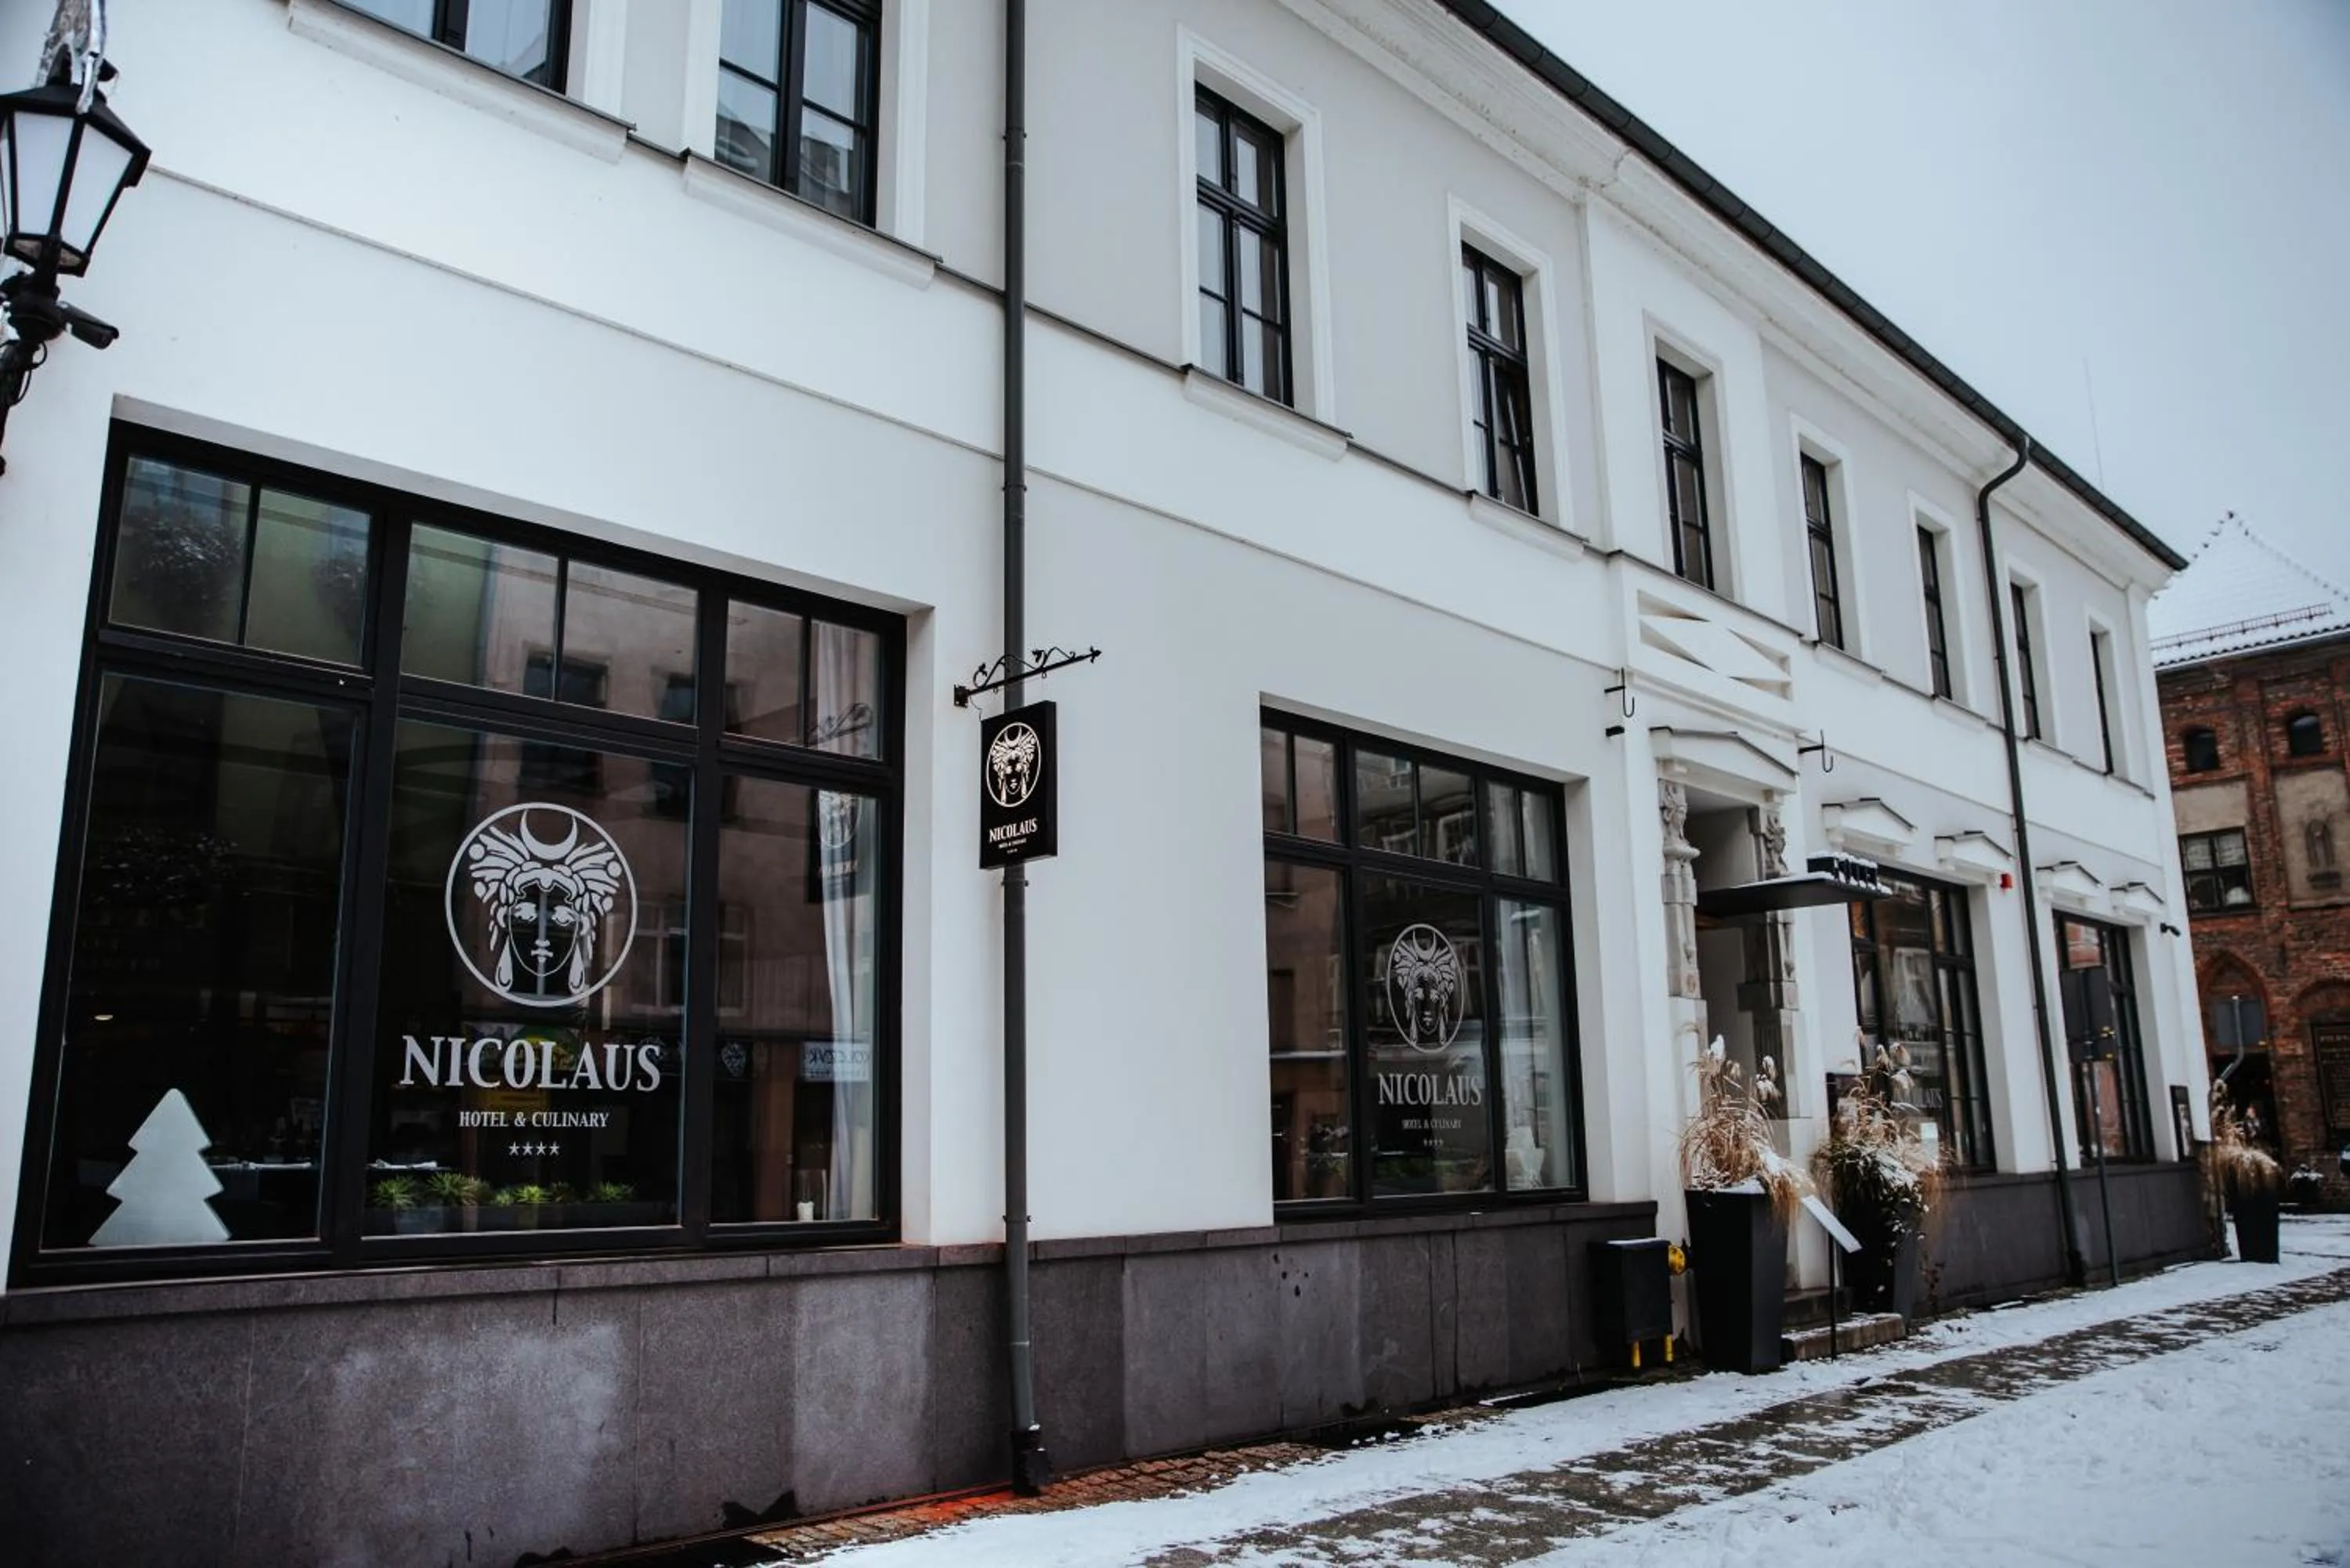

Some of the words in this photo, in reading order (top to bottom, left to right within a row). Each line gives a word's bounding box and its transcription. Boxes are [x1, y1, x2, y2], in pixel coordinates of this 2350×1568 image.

[989, 818, 1038, 844] NICOLAUS
[400, 1035, 661, 1091] NICOLAUS
[1378, 1073, 1481, 1106] NICOLAUS
[459, 1111, 508, 1127] HOTEL
[514, 1112, 526, 1127] &
[532, 1112, 609, 1128] CULINARY
